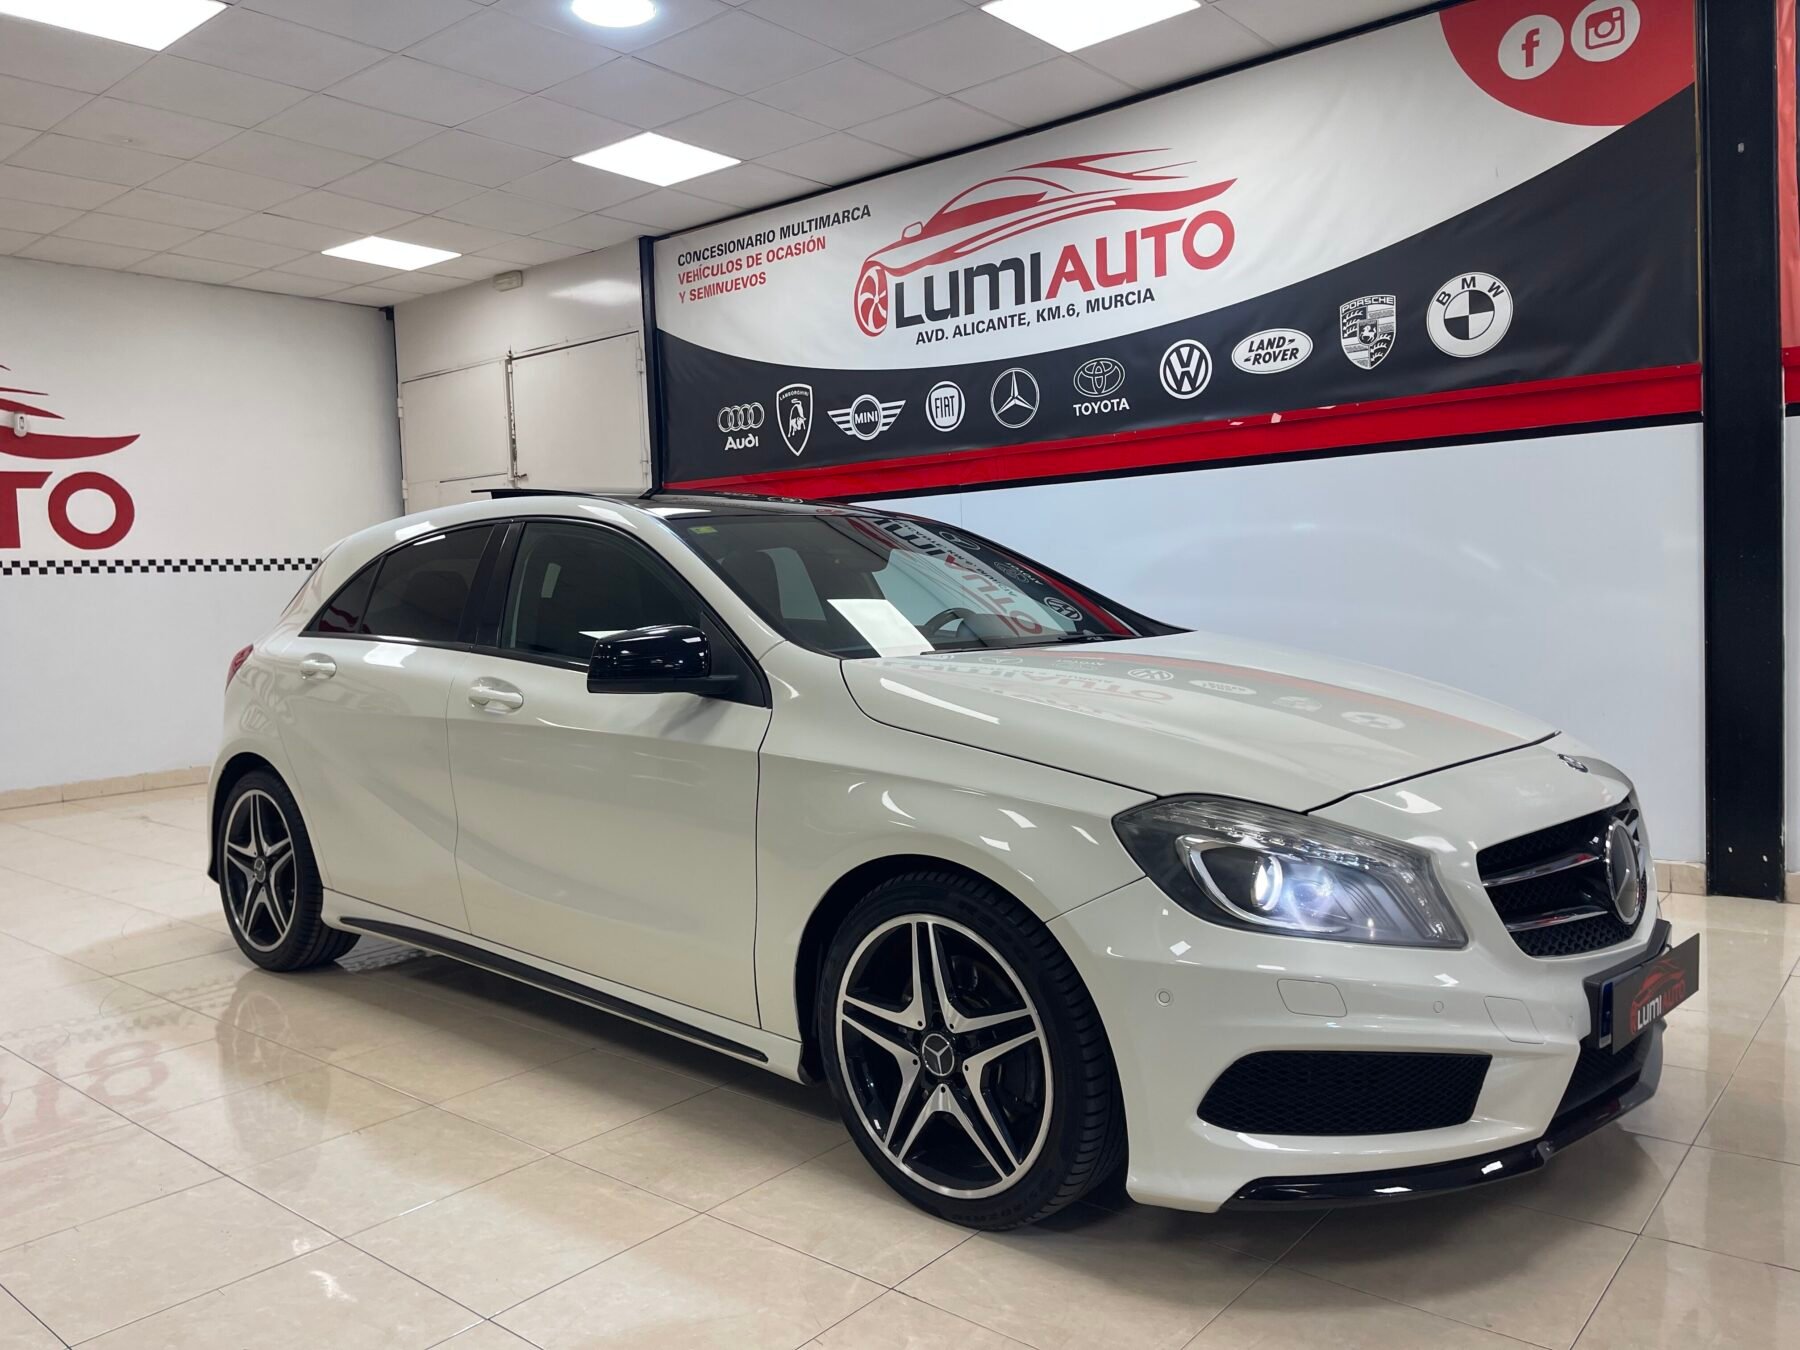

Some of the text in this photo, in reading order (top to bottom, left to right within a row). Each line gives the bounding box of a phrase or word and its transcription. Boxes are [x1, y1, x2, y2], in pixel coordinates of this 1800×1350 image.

[677, 204, 872, 267] CONCESIONARIO MULTIMARCA
[677, 235, 827, 285] VEHÍCULOS DE OCASIÓN
[678, 271, 768, 304] Y SEMINUEVOS
[915, 287, 1156, 346] AVD. ALICANTE, KM.6, MURCIA
[1341, 296, 1394, 314] PORSCHE
[854, 410, 879, 425] MINI
[935, 395, 956, 419] FIAT
[1073, 397, 1131, 417] TOYOTA
[724, 433, 759, 451] Audi
